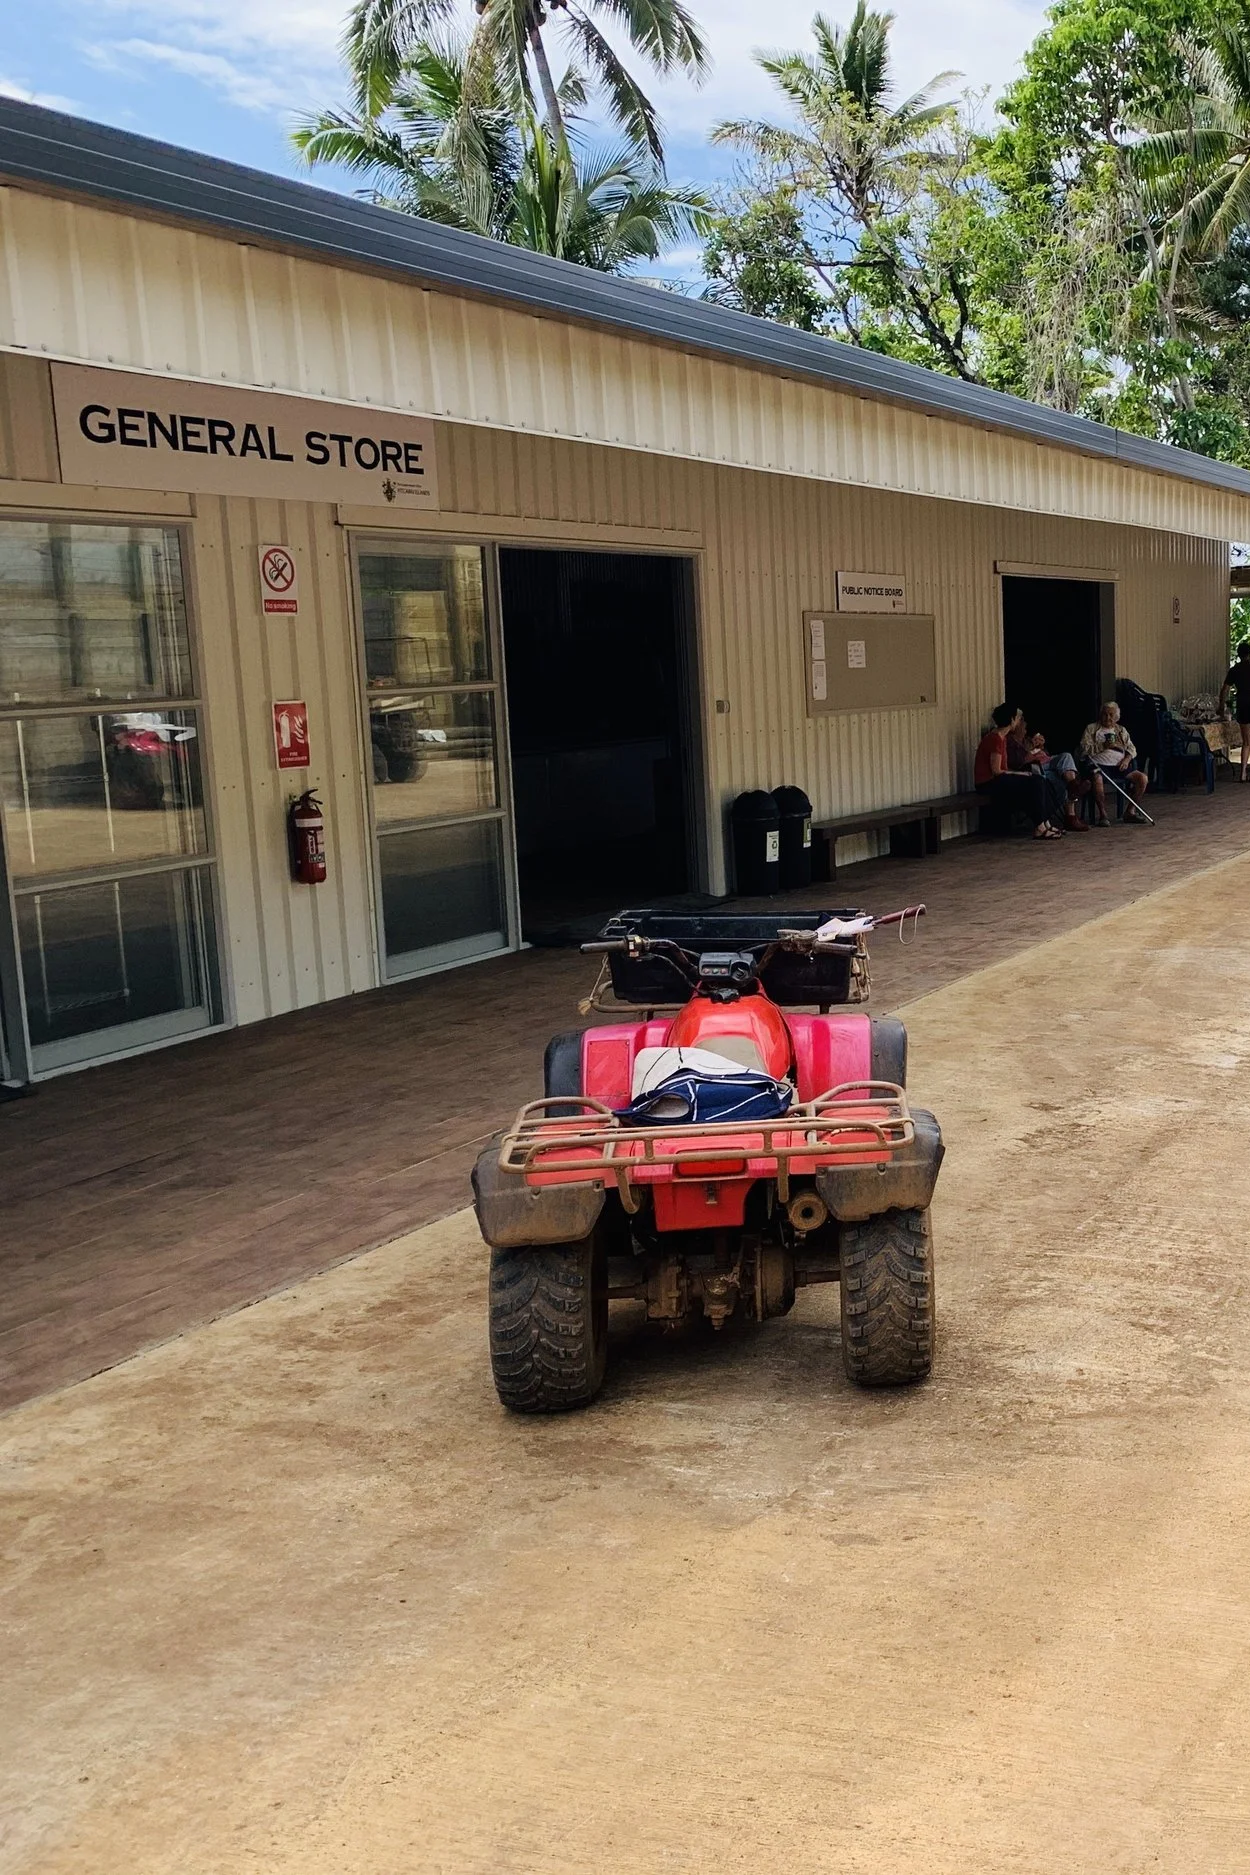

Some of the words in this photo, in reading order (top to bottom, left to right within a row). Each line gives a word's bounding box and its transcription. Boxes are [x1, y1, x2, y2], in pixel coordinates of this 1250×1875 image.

[79, 404, 294, 463] GENERAL
[306, 431, 425, 476] STORE
[842, 586, 863, 595] PUBLIC
[864, 587, 884, 596] NOTICE
[885, 588, 903, 597] BOARD
[273, 603, 297, 611] smoking
